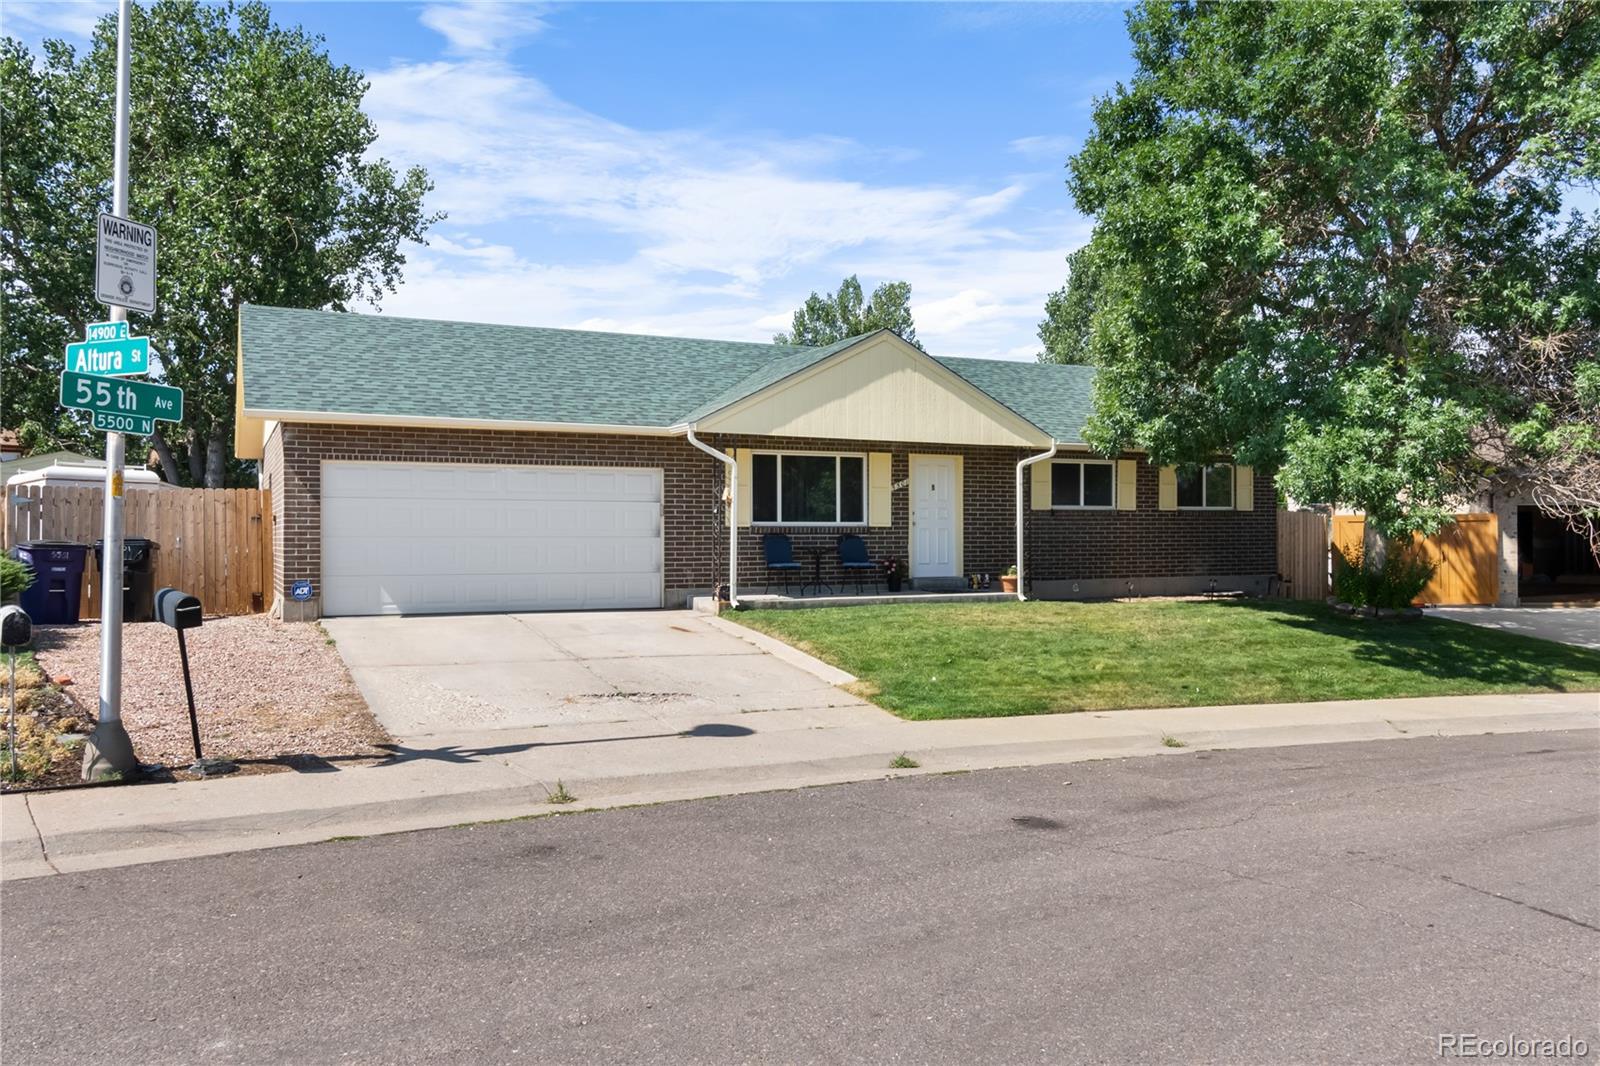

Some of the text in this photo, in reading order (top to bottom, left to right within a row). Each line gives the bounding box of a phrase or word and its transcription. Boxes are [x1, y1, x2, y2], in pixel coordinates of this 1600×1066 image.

[102, 218, 152, 247] WARNING
[88, 324, 127, 339] 14900 E
[75, 348, 142, 373] Altura St
[76, 378, 173, 411] 55th Ave
[97, 414, 151, 433] 5500 N
